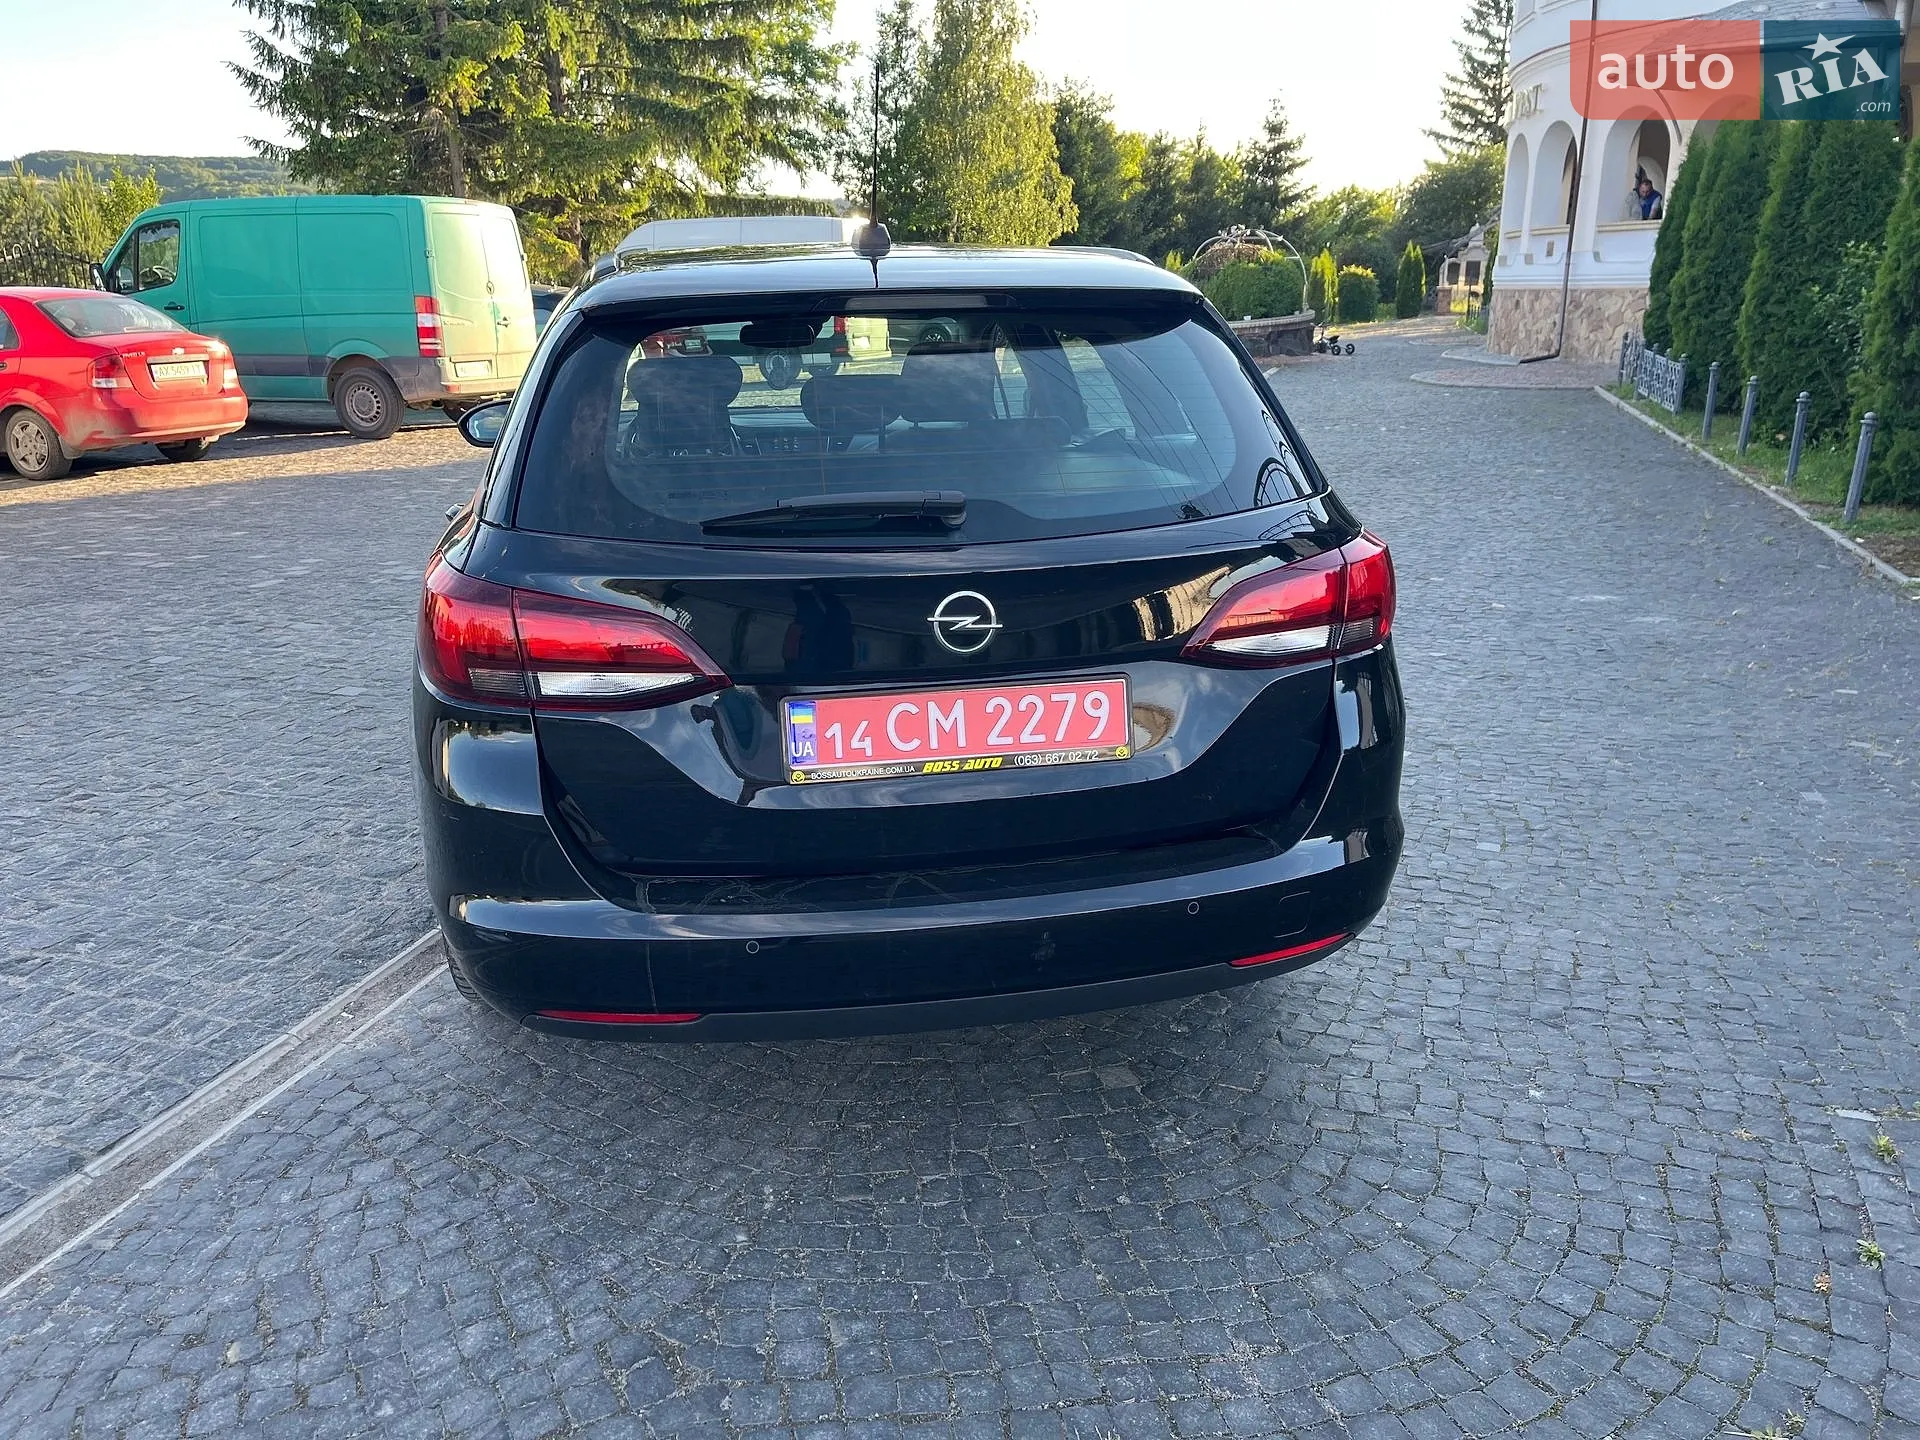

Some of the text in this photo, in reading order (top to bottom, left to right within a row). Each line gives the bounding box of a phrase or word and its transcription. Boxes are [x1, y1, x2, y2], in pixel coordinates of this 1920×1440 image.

[824, 690, 1110, 759] 14 CM 2279
[792, 741, 814, 757] UA
[922, 756, 1003, 773] BOSS AUTO
[1014, 754, 1042, 766] (063)
[1045, 752, 1065, 764] 667
[811, 765, 915, 780] BOSSAUTOUKRAINE.COM.UA
